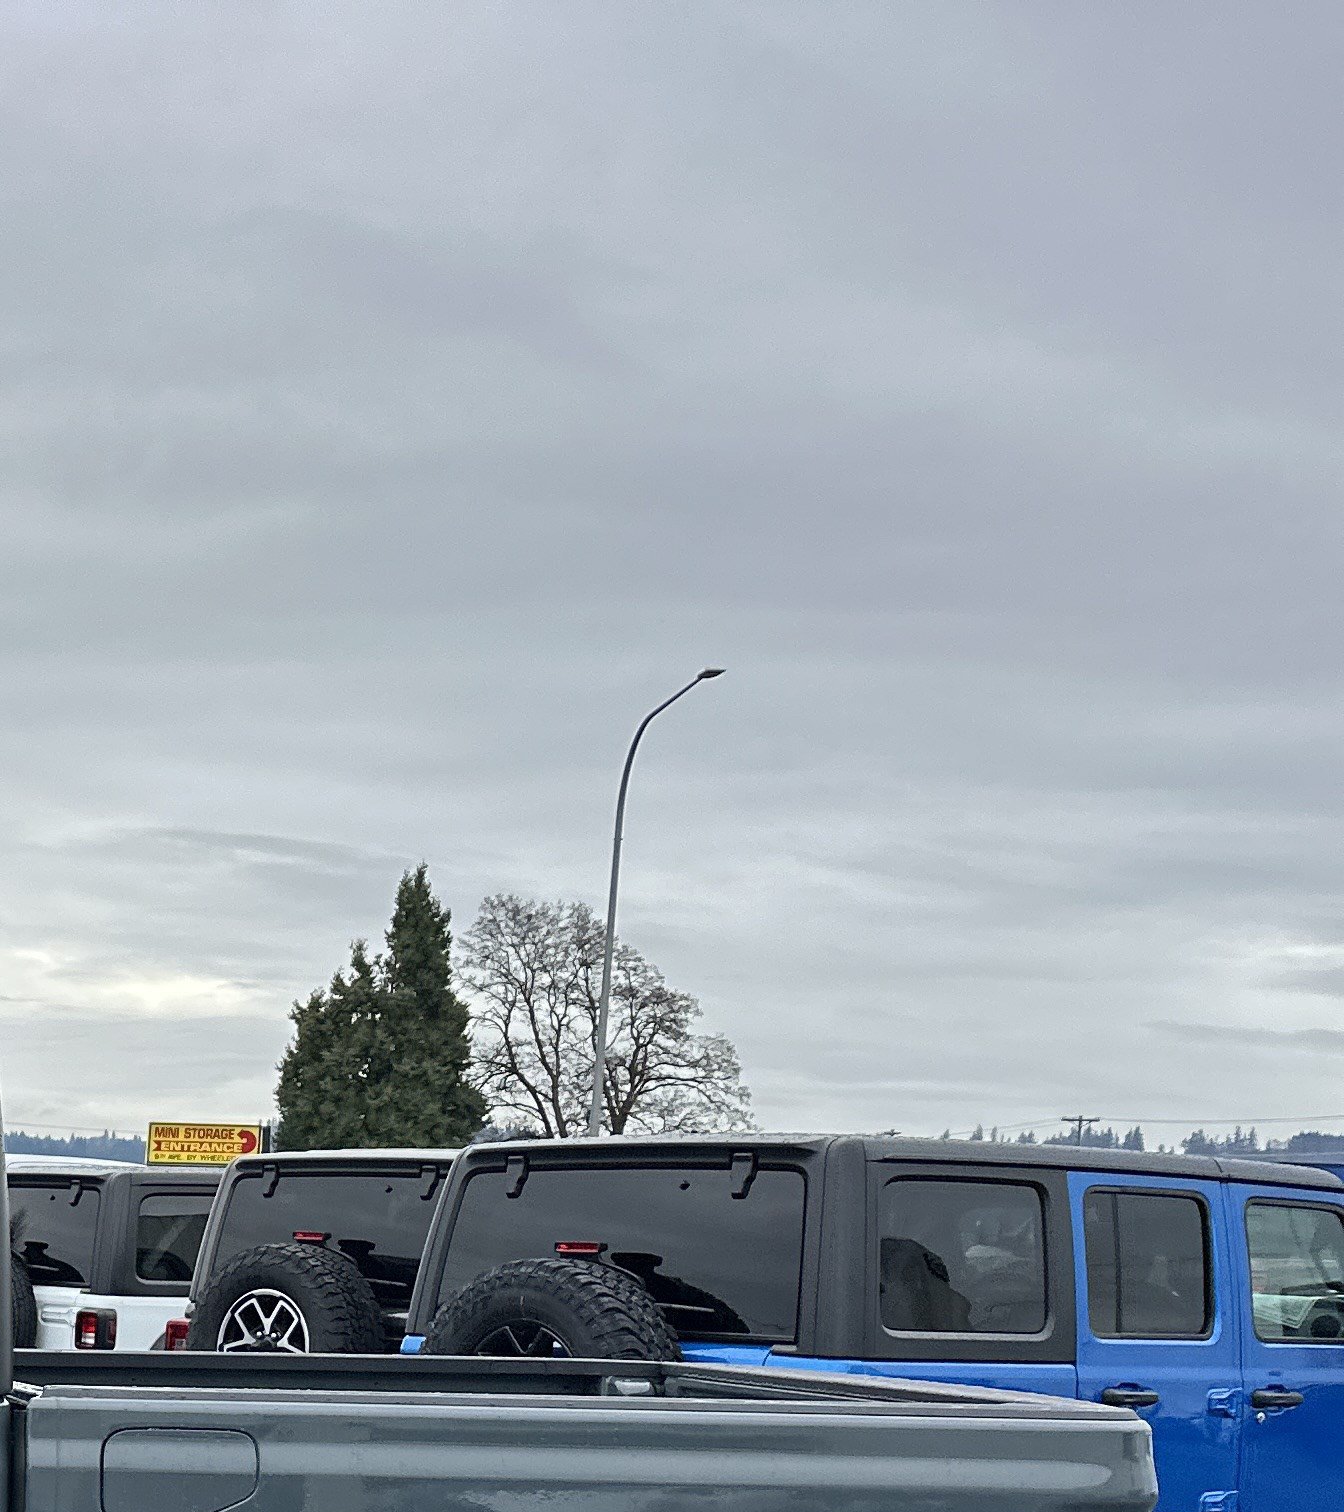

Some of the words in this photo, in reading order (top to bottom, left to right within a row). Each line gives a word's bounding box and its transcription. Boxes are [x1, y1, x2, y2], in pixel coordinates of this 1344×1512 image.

[154, 1127, 179, 1139] MINI
[184, 1127, 235, 1140] STORAGE
[160, 1142, 242, 1152] ENTRANCE
